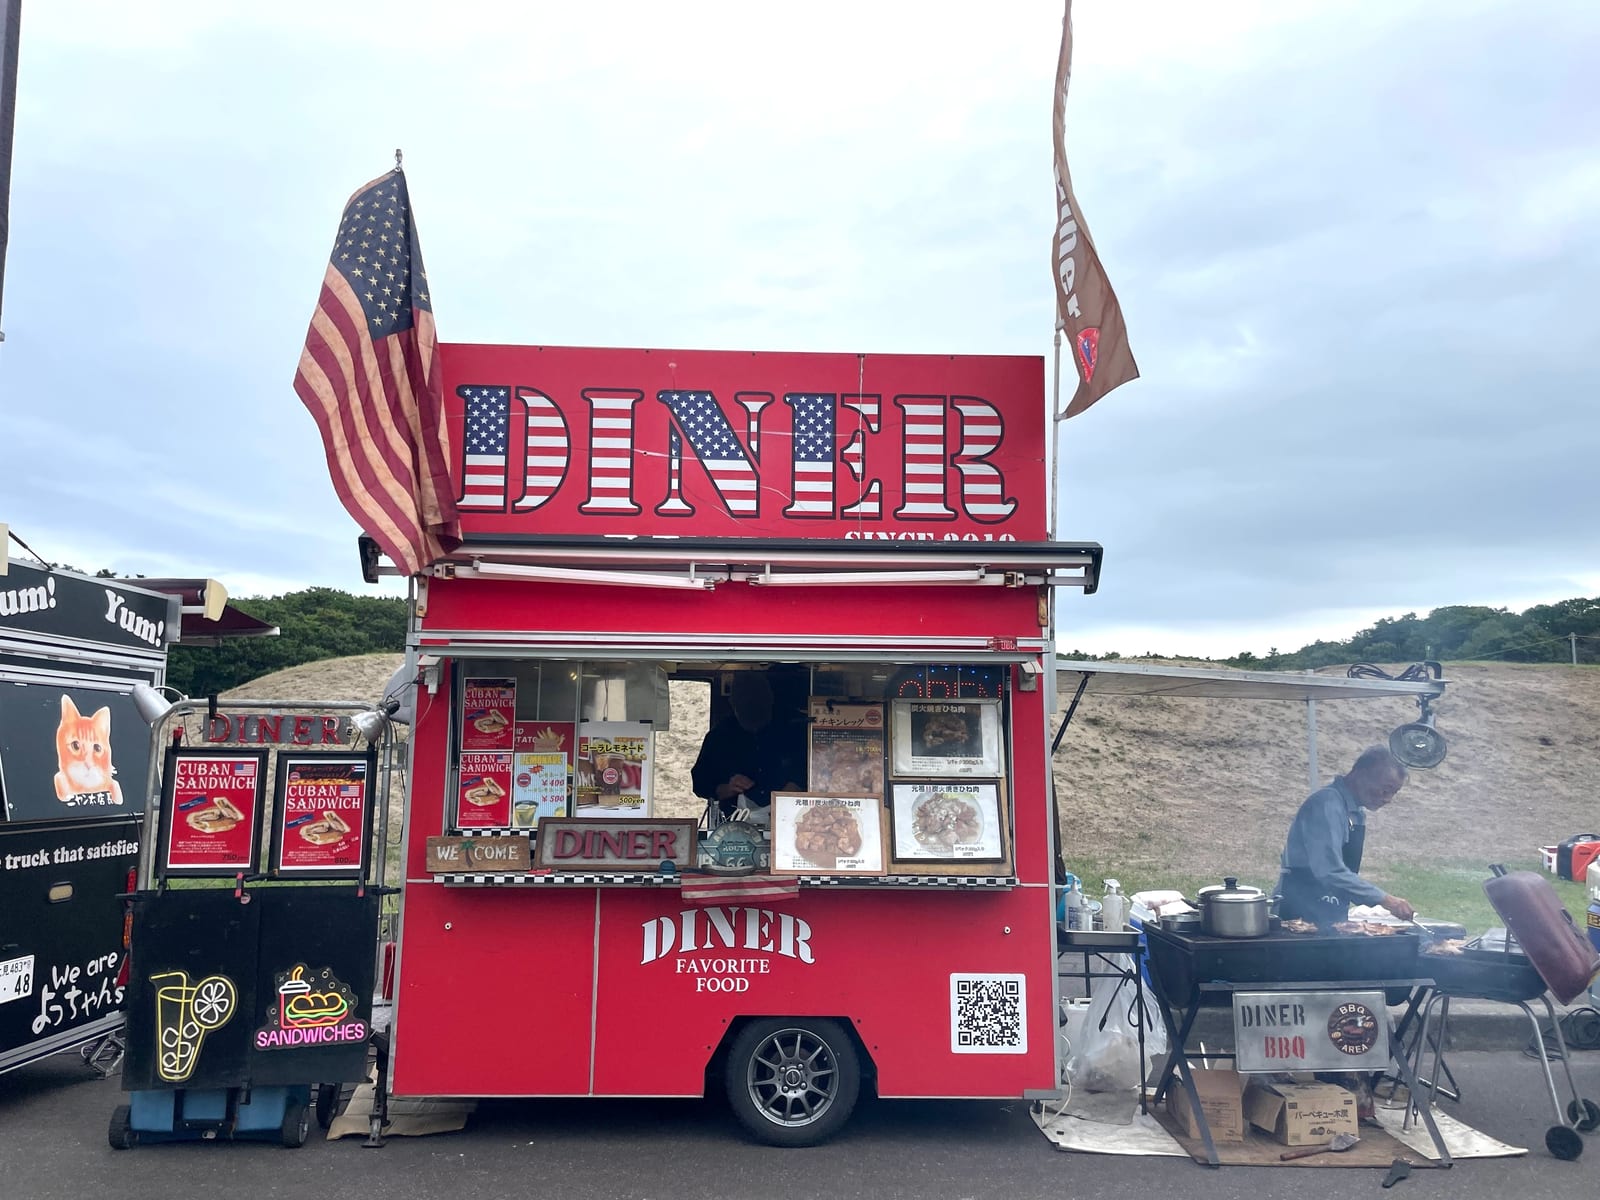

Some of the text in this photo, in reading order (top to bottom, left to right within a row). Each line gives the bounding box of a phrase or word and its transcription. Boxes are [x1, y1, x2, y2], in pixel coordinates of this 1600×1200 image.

[455, 384, 1018, 524] DINER
[105, 589, 165, 648] Yum!
[465, 690, 499, 698] CUBAN
[464, 699, 514, 708] SANDWICH
[208, 712, 342, 746] DINER
[819, 718, 865, 727] チキンレッグ
[581, 743, 645, 753] コーラレモネード
[461, 754, 495, 763] CUBAN
[177, 763, 231, 776] CUBAN
[460, 763, 511, 773] SANDWICH
[176, 776, 256, 789] SANDWICH
[288, 785, 338, 797] CUBAN
[287, 796, 361, 809] SANDWICH
[619, 797, 645, 805] 500yen
[553, 829, 678, 859] DINER
[5, 839, 139, 870] truck that satisfies
[640, 906, 815, 965] DINER
[52, 952, 118, 990] We are
[675, 958, 770, 974] FAVORITE
[696, 977, 749, 993] FOOD
[1241, 1004, 1305, 1027] DINER
[1339, 1004, 1366, 1015] BBQ
[256, 1023, 365, 1047] SANDWICHES
[1264, 1035, 1305, 1059] BBQ
[1341, 1043, 1369, 1054] AREA
[1295, 1108, 1349, 1119] バーベキュー木炭
